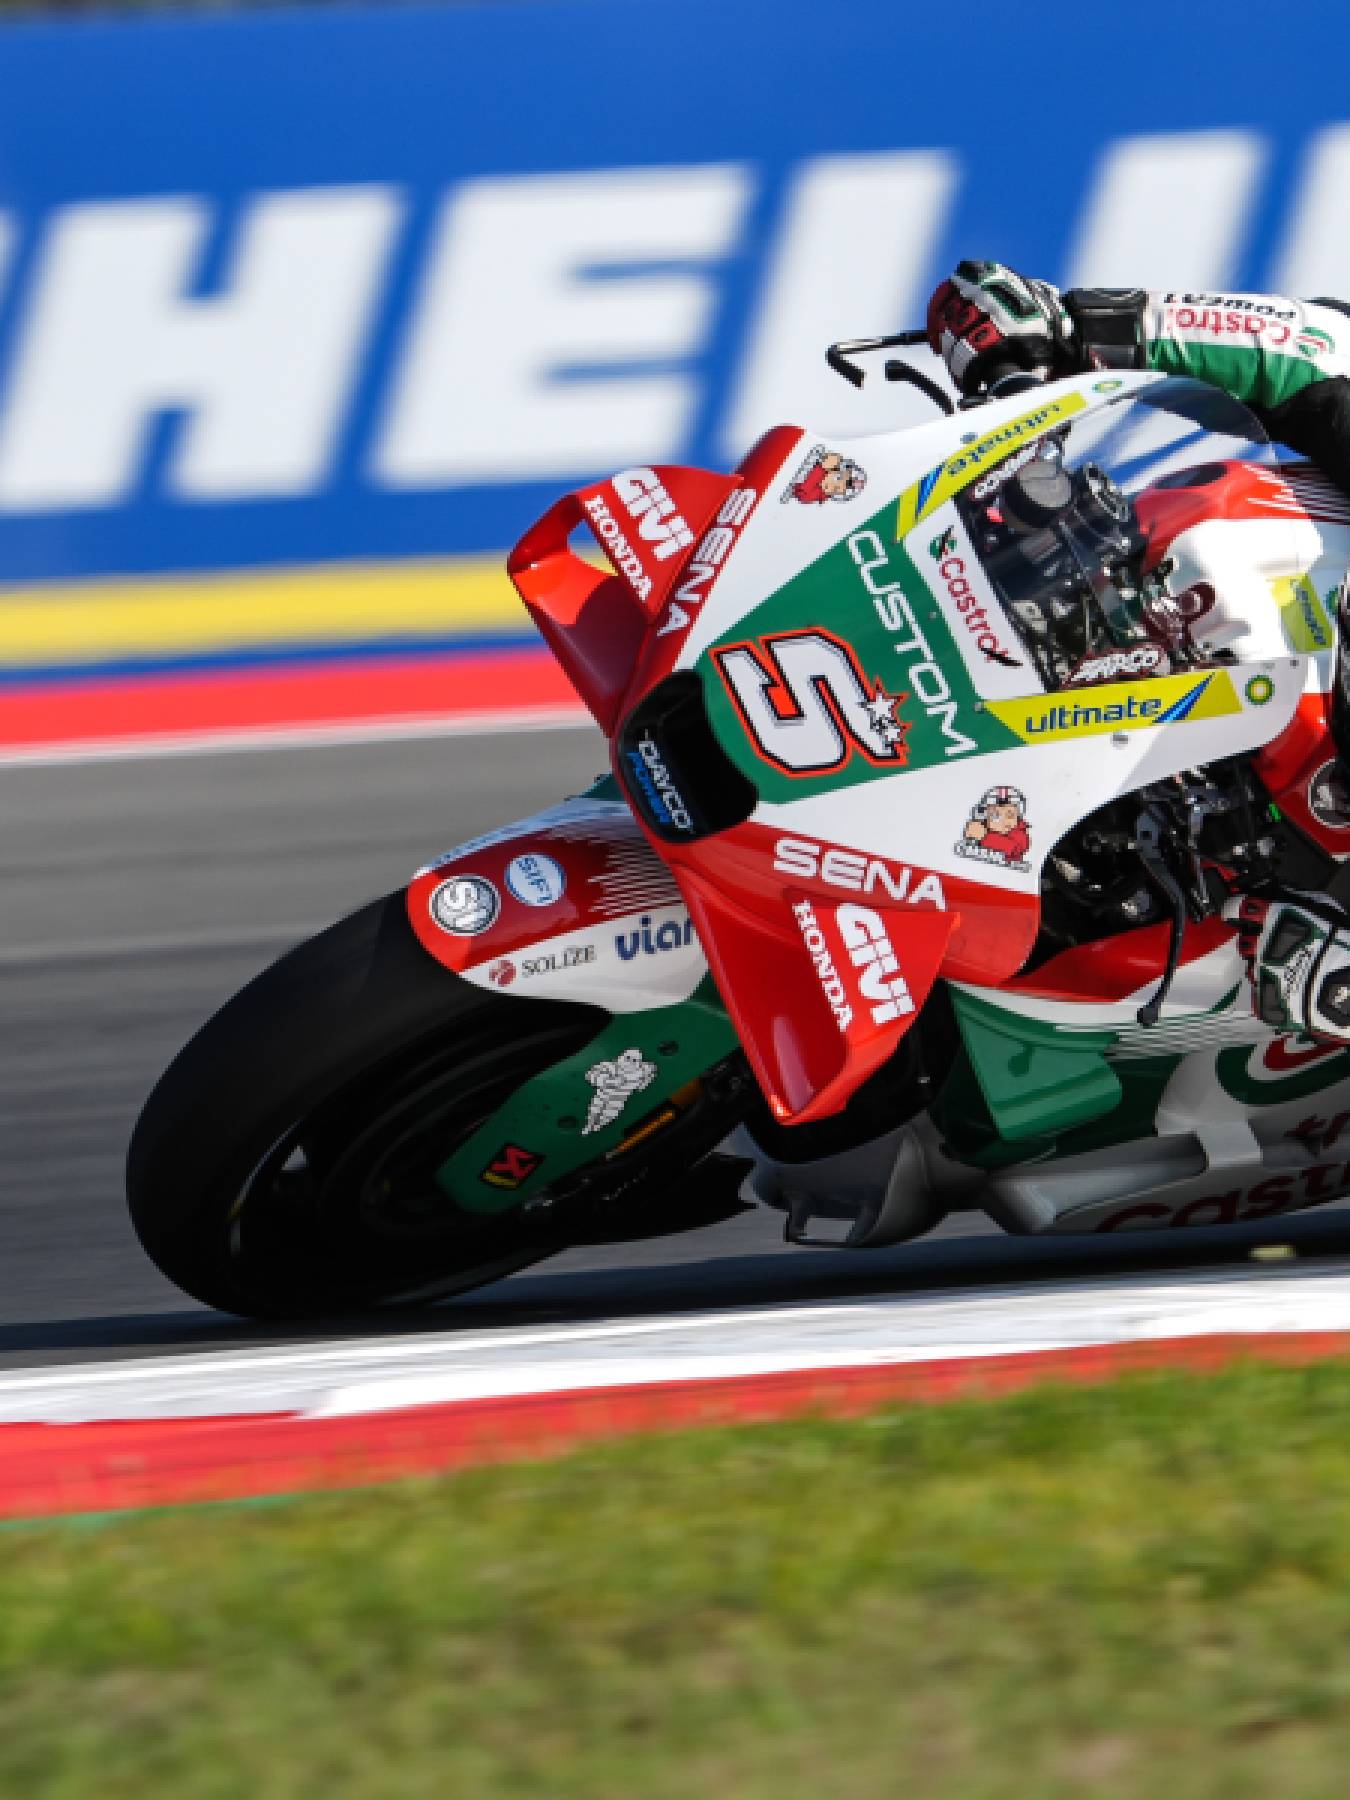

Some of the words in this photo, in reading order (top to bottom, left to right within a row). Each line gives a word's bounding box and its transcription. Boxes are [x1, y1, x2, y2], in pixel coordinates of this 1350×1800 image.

[1167, 306, 1292, 347] Castrol
[947, 402, 1062, 476] ultimate
[584, 495, 653, 601] HONDA
[610, 466, 696, 561] GIVI
[656, 488, 757, 636] SENA
[847, 530, 978, 757] CUSTOM
[938, 557, 1010, 665] Castrol
[708, 627, 908, 778] 5
[1025, 696, 1162, 733] ultimate
[638, 740, 695, 832] DAYCO
[773, 837, 948, 910] SENA
[521, 944, 596, 978] SOLIZE
[792, 900, 854, 1032] HONDA
[836, 902, 916, 1024] GIVI
